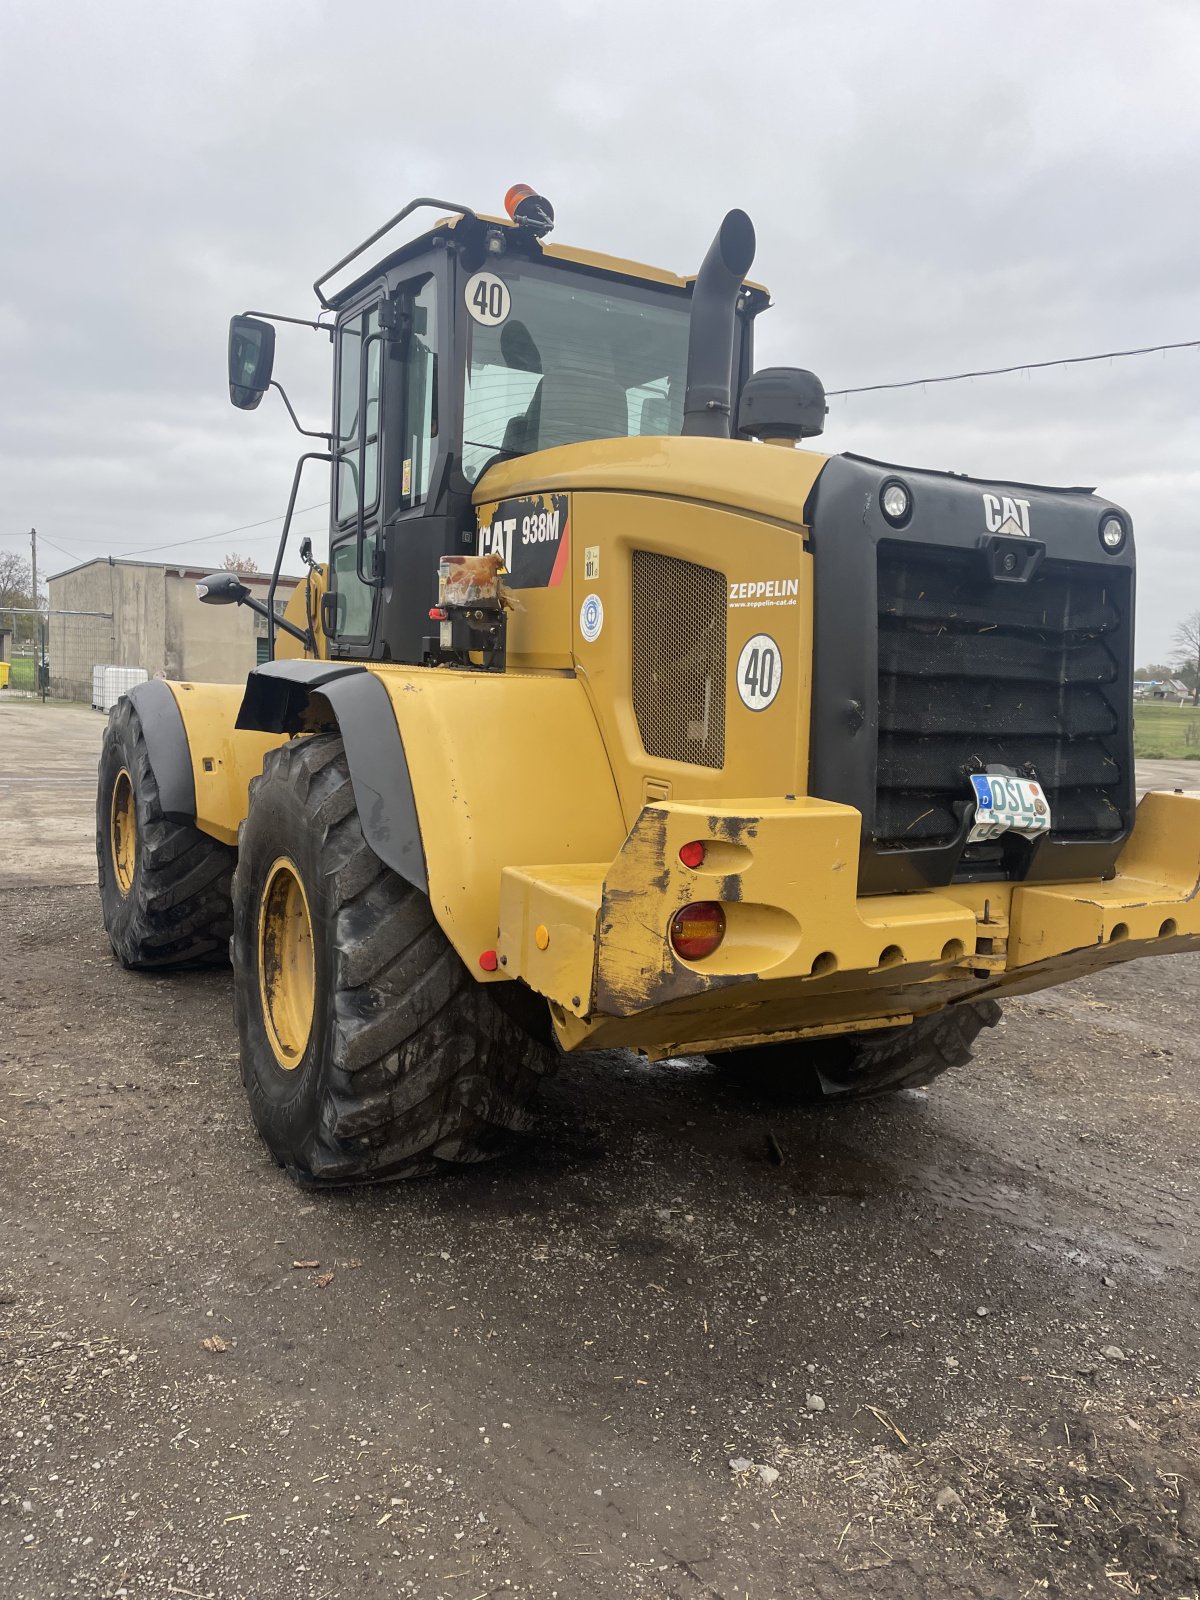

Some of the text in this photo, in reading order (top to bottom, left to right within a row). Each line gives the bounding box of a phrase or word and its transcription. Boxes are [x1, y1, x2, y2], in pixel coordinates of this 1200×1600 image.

[472, 280, 503, 318] 40
[522, 510, 560, 545] 938M
[982, 493, 1031, 537] CAT
[729, 578, 799, 599] ZEPPELIN
[729, 598, 797, 608] www.zeppelin-cat.de
[744, 648, 775, 698] 40
[982, 795, 989, 805] D
[990, 779, 1034, 813] OSL
